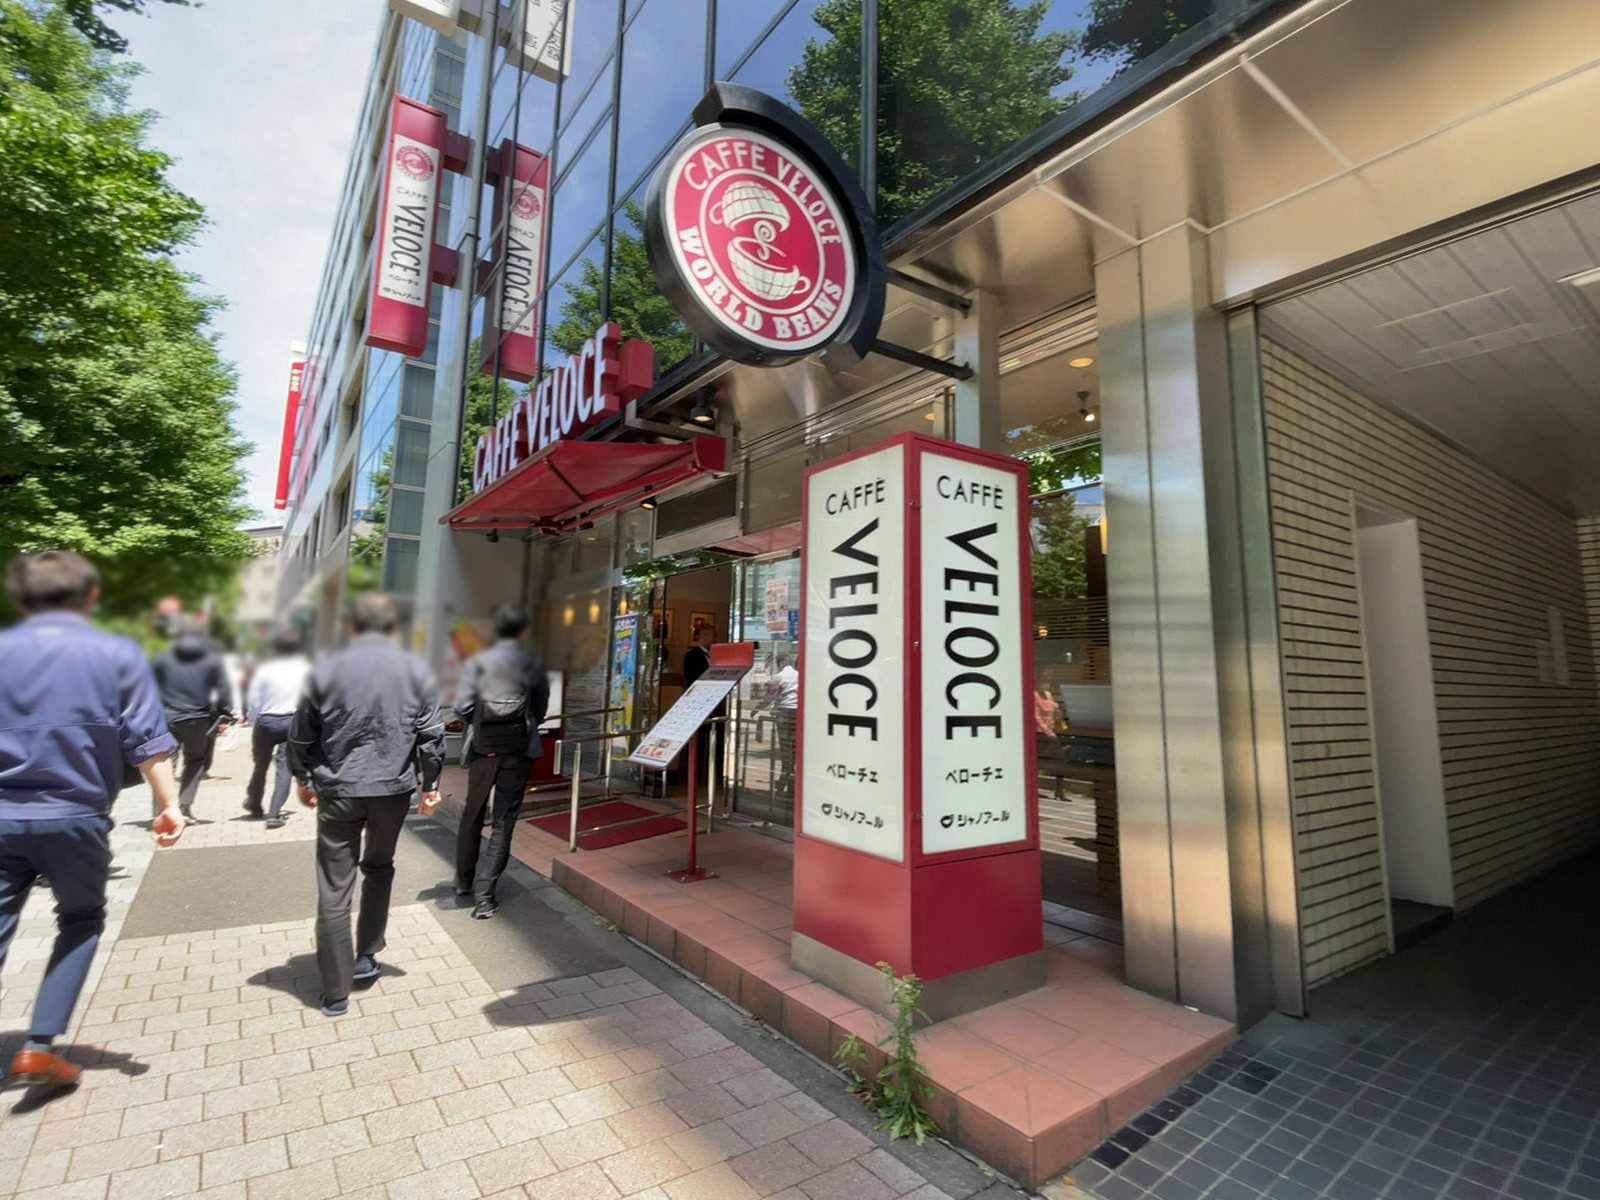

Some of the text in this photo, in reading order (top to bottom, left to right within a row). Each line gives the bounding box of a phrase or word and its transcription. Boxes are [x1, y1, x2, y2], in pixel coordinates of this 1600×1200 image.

[389, 205, 427, 277] VELOCE
[684, 141, 842, 245] CAFFE VELOCE
[679, 225, 844, 340] WORLD BEANS
[473, 323, 608, 495] CAFFE VELOCE
[828, 517, 879, 742] VELOCE
[944, 522, 1002, 740] VELOCE
[834, 805, 884, 829] シャノアール
[957, 810, 1010, 828] シャノアール
